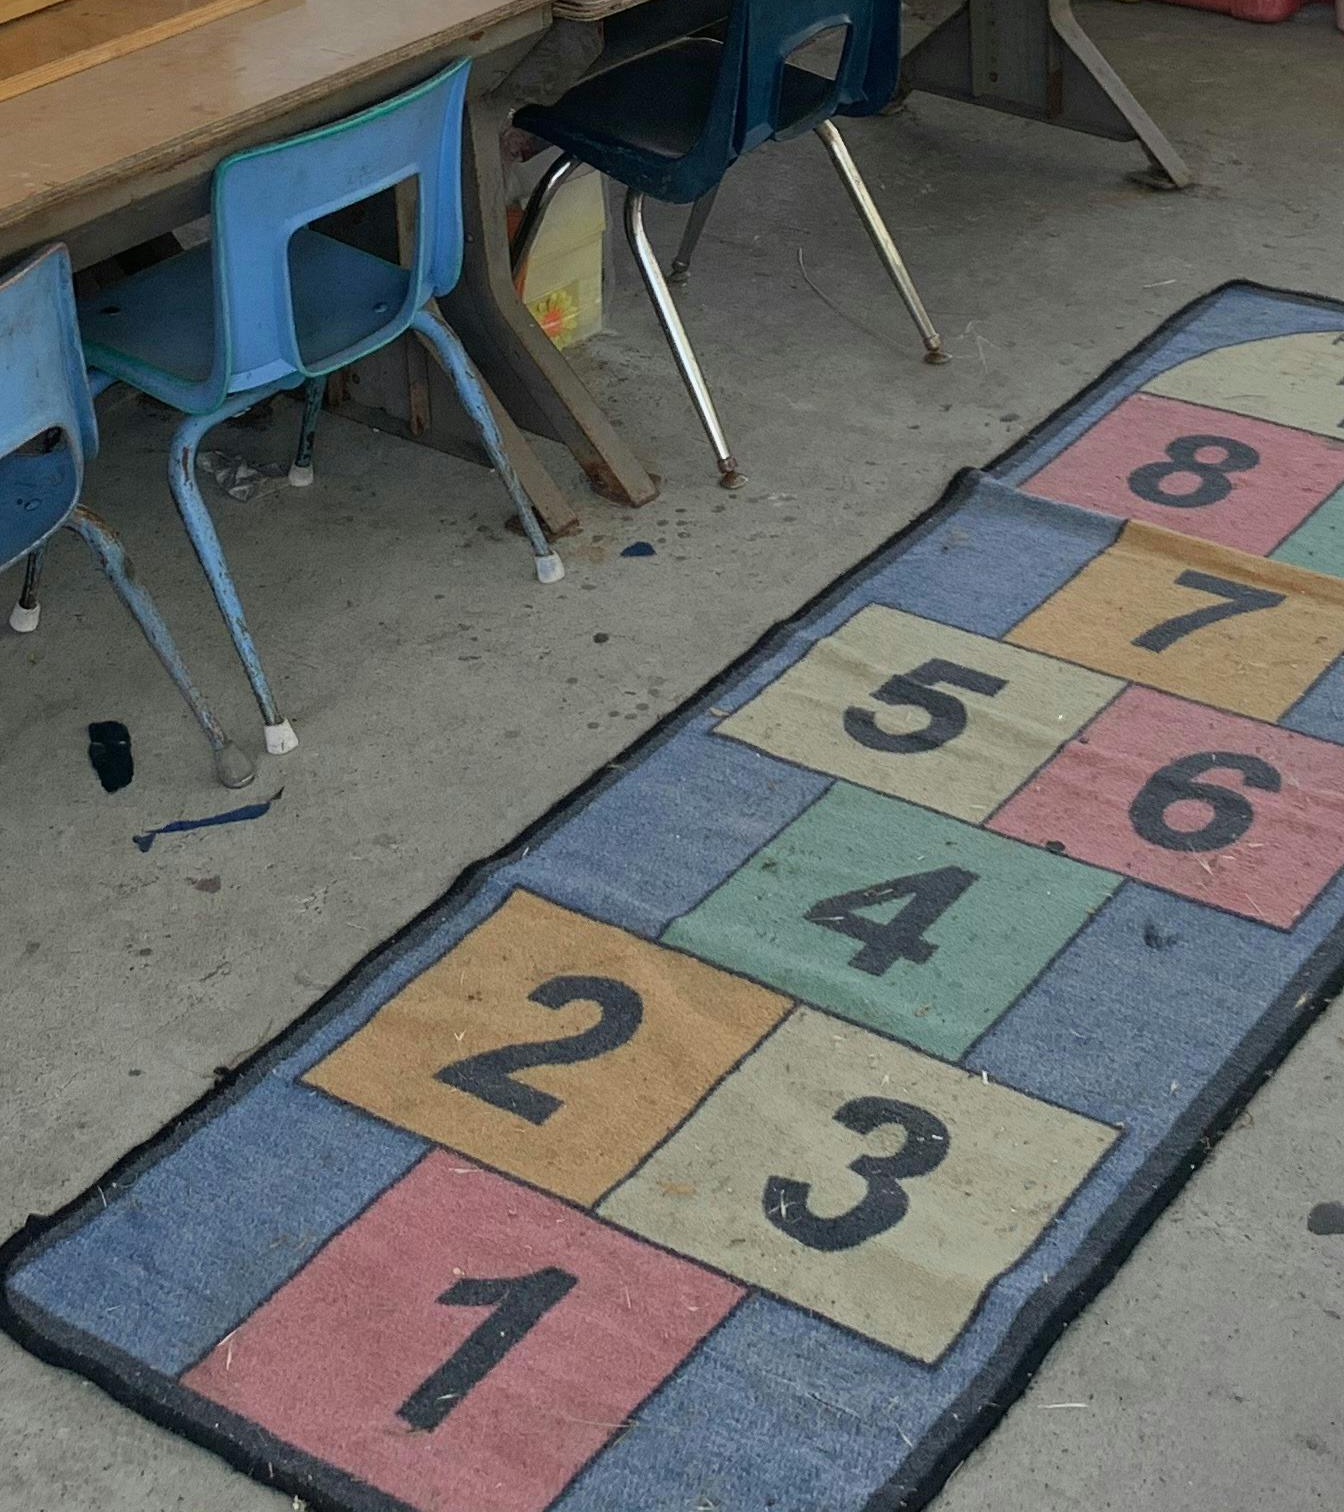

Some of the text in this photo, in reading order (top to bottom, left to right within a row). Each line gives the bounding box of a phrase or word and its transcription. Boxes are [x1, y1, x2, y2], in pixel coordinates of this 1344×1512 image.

[1127, 435, 1260, 508] 8
[1131, 570, 1287, 654] 7
[843, 659, 1008, 754] 5
[1130, 752, 1284, 852] 6
[803, 866, 976, 977] 4
[434, 976, 643, 1126] 2
[762, 1097, 950, 1252] 3
[395, 1266, 576, 1432] 1
